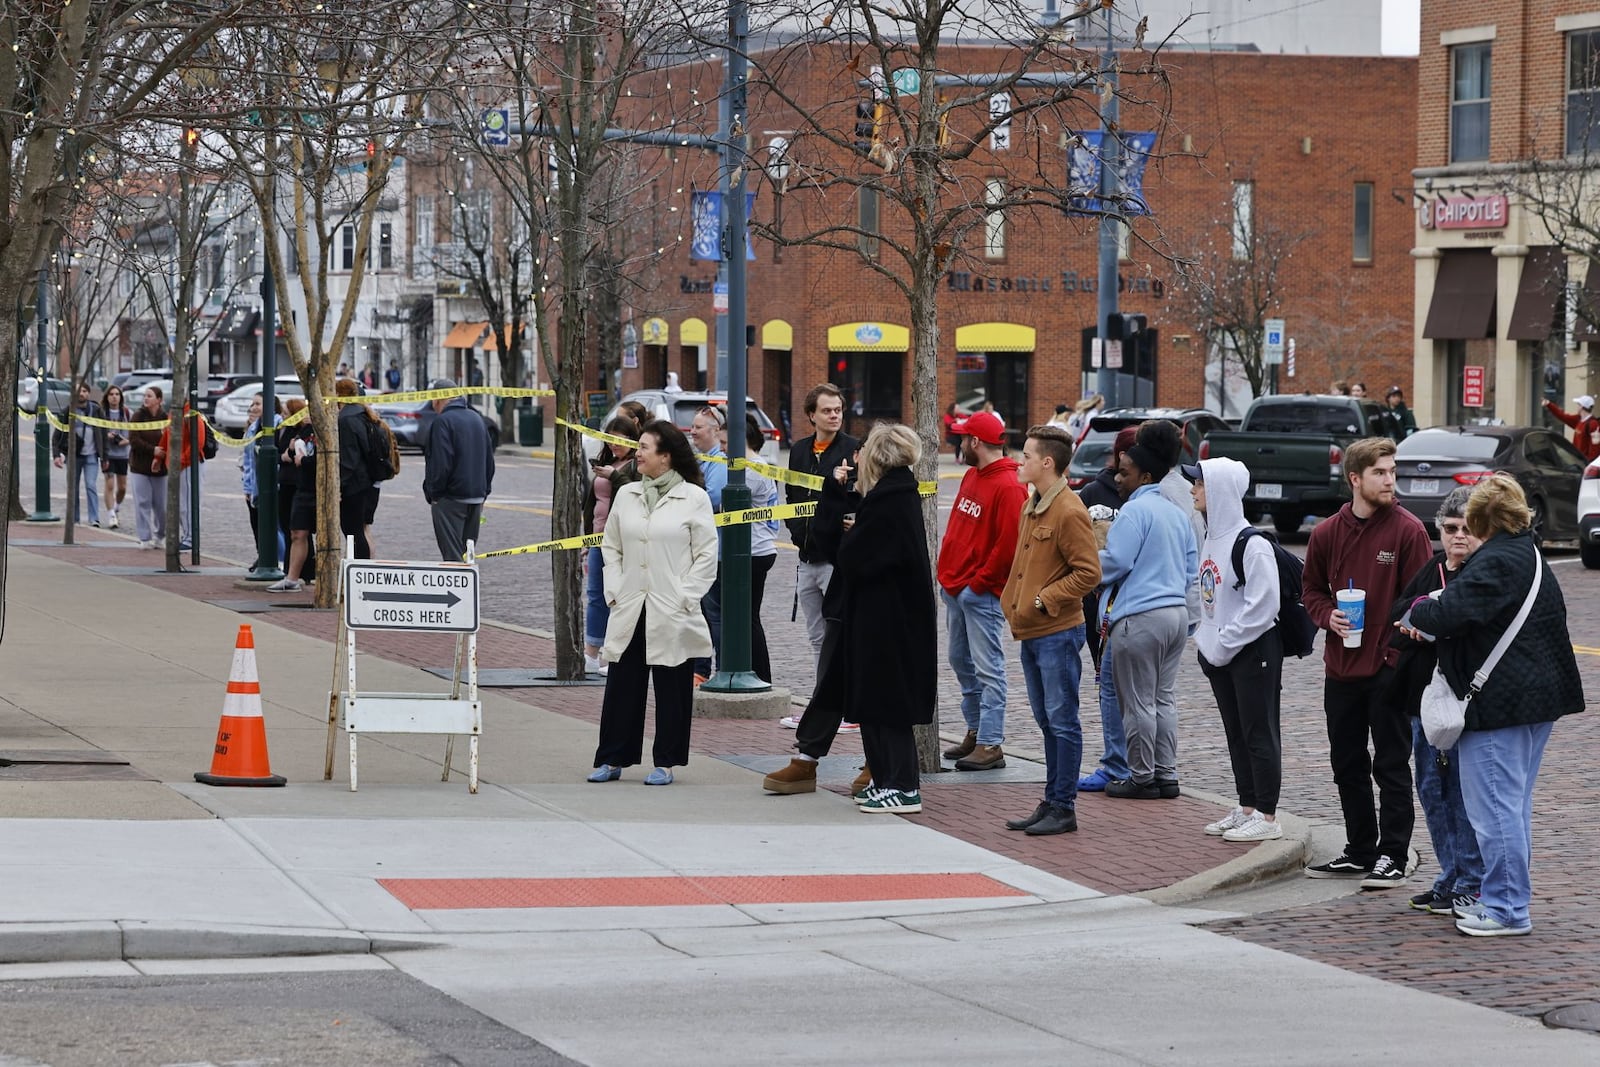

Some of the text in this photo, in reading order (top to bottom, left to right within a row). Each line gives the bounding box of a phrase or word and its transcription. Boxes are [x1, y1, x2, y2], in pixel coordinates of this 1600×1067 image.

[1436, 200, 1502, 222] CHIPOTLE
[947, 271, 1164, 298] Masonic Buing
[742, 508, 773, 523] CUIDADO
[794, 503, 817, 517] UTION
[957, 497, 981, 518] AERO
[582, 535, 604, 548] UTION
[355, 571, 469, 588] SIDEWALK CLOSED
[373, 609, 452, 624] CROSS HERE
